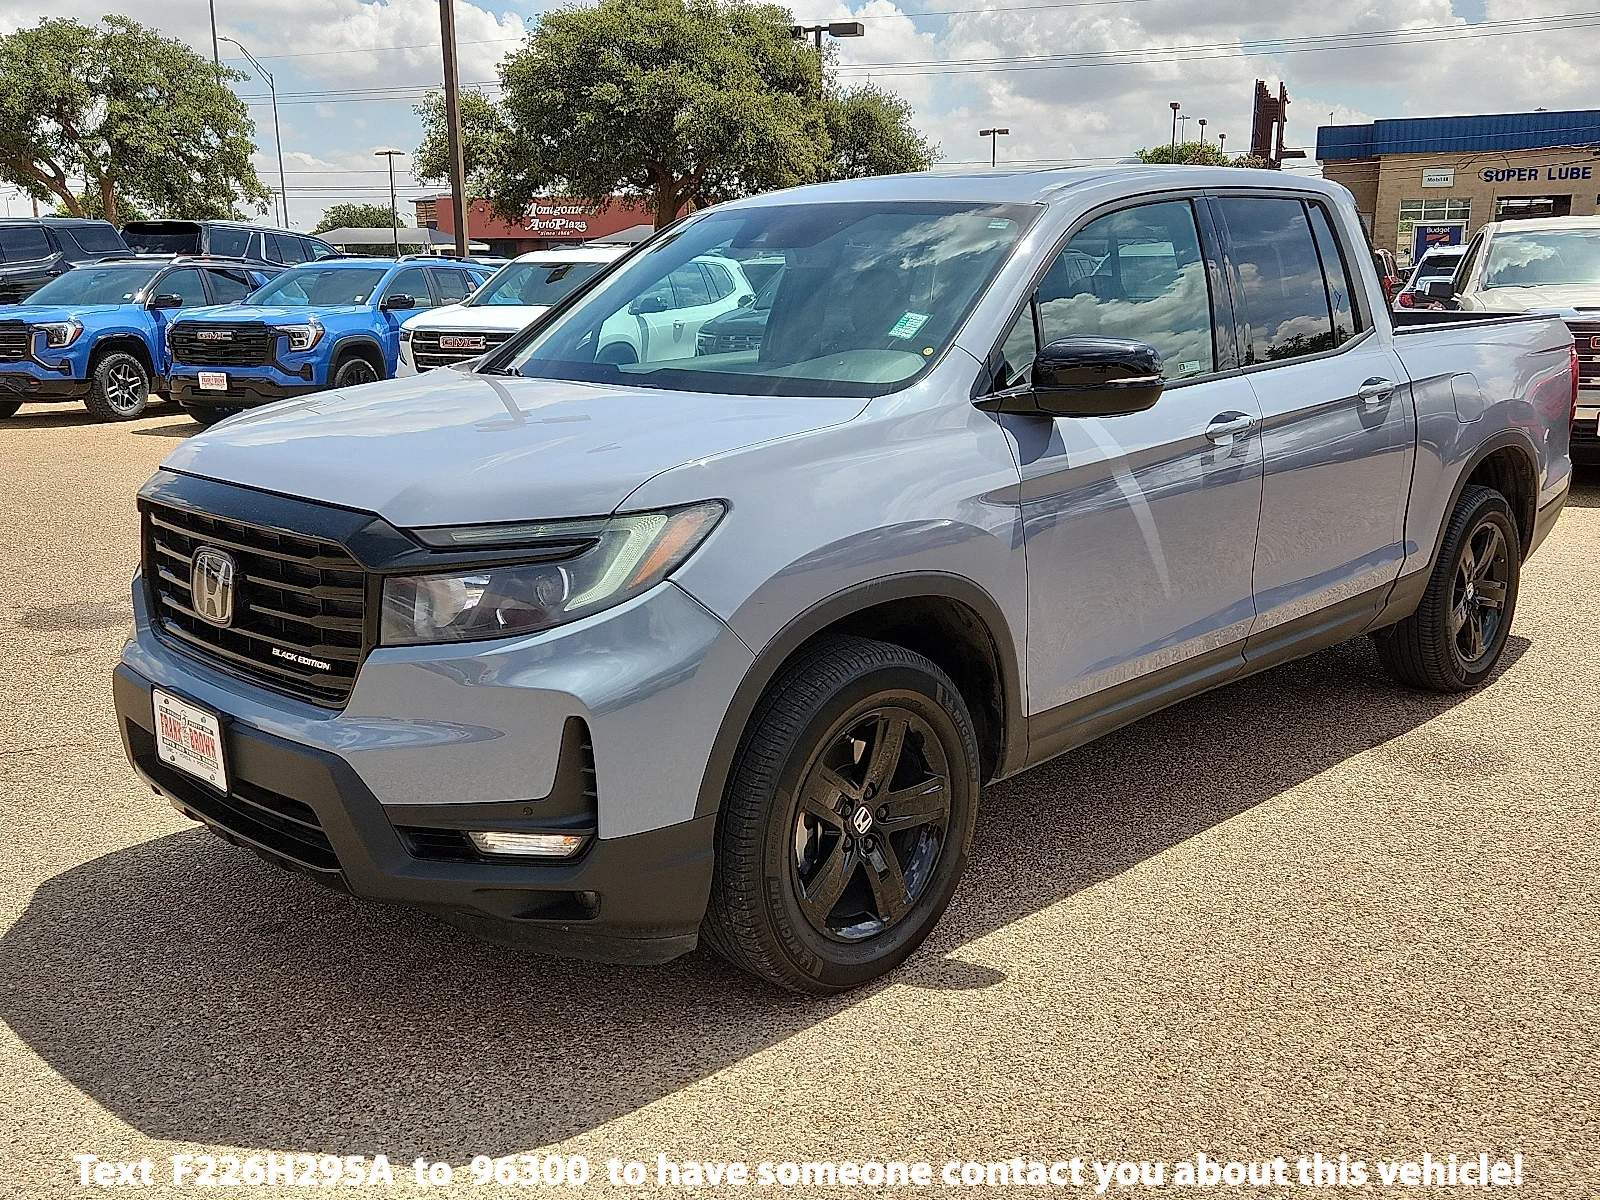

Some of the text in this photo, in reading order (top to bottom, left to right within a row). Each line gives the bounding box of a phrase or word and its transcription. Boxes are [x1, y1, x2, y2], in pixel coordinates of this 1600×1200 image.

[1483, 167, 1593, 182] SUPER LUBE
[1426, 226, 1450, 234] Budget
[197, 331, 233, 340] GMC
[440, 336, 485, 348] GMC
[272, 647, 331, 671] BLACK EDITION
[160, 712, 183, 746] FRANK
[188, 727, 218, 762] BROWN
